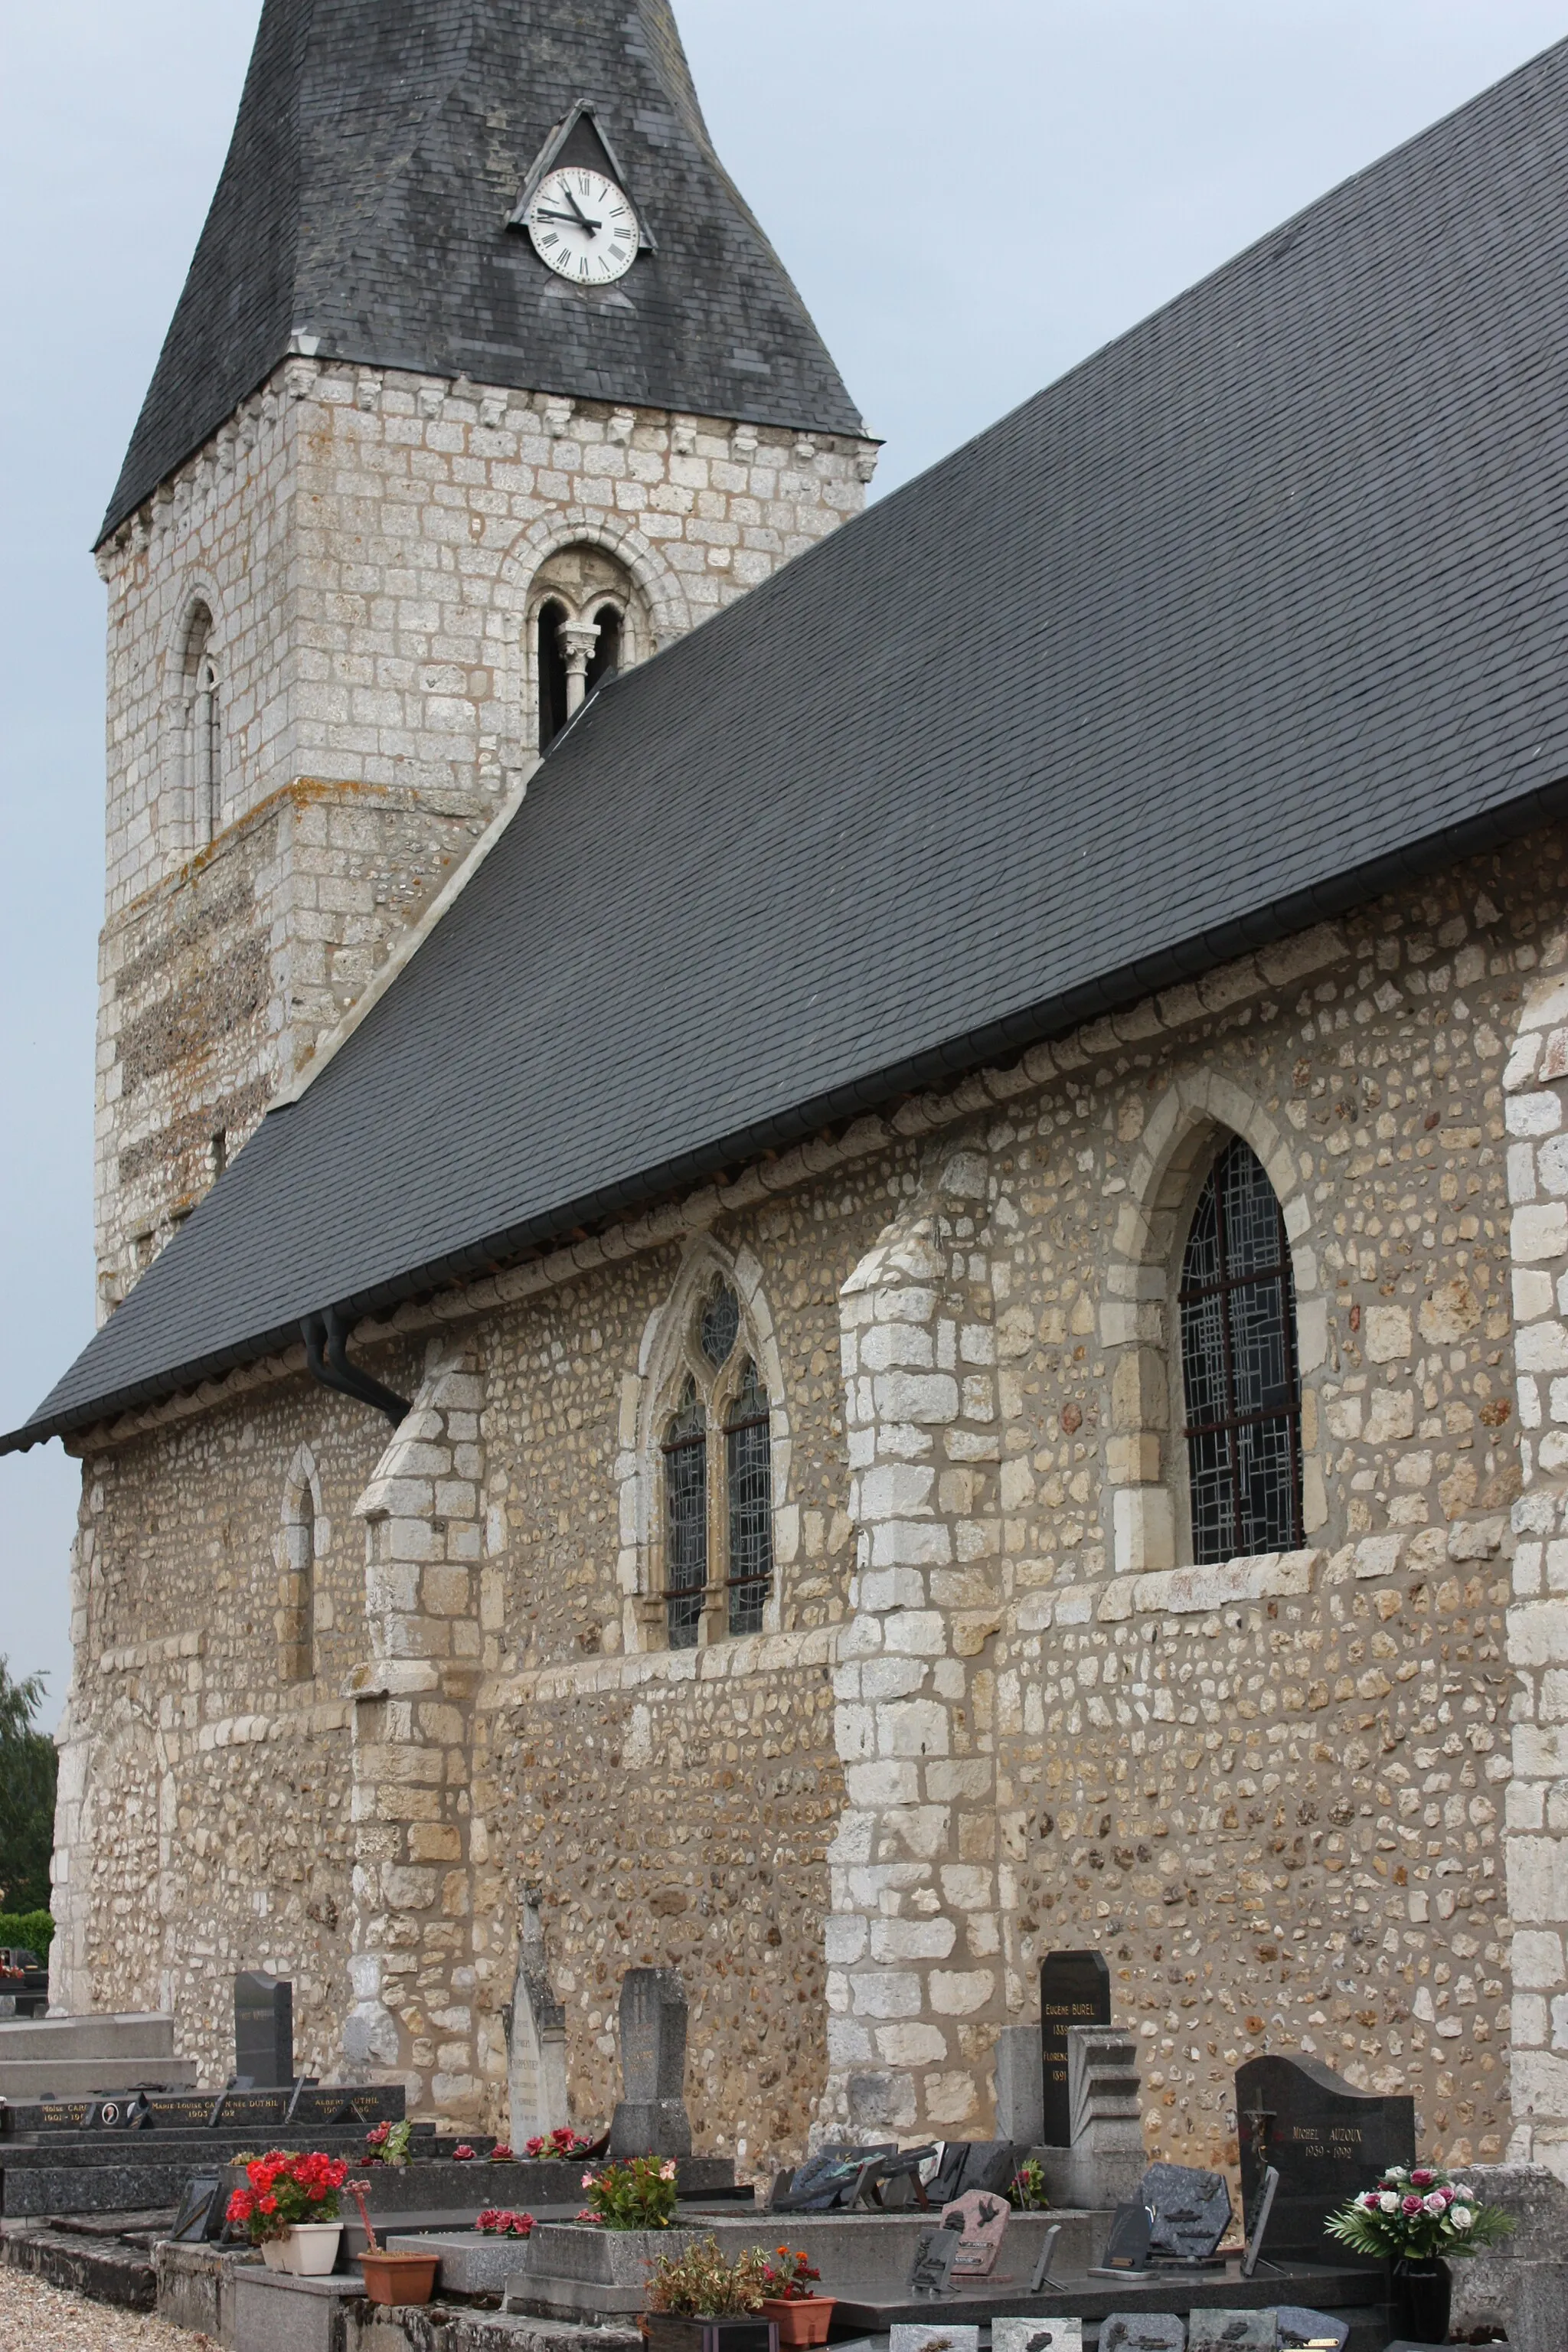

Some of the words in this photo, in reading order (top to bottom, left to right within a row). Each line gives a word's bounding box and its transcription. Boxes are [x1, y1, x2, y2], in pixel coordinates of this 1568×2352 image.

[578, 177, 590, 196] XII
[613, 227, 632, 240] III
[1072, 2003, 1095, 2015] BUREL
[1292, 2126, 1319, 2140] MICHEL
[1329, 2128, 1362, 2142] AUZOUX
[1305, 2145, 1324, 2157] 1939
[1333, 2146, 1351, 2159] 1992
